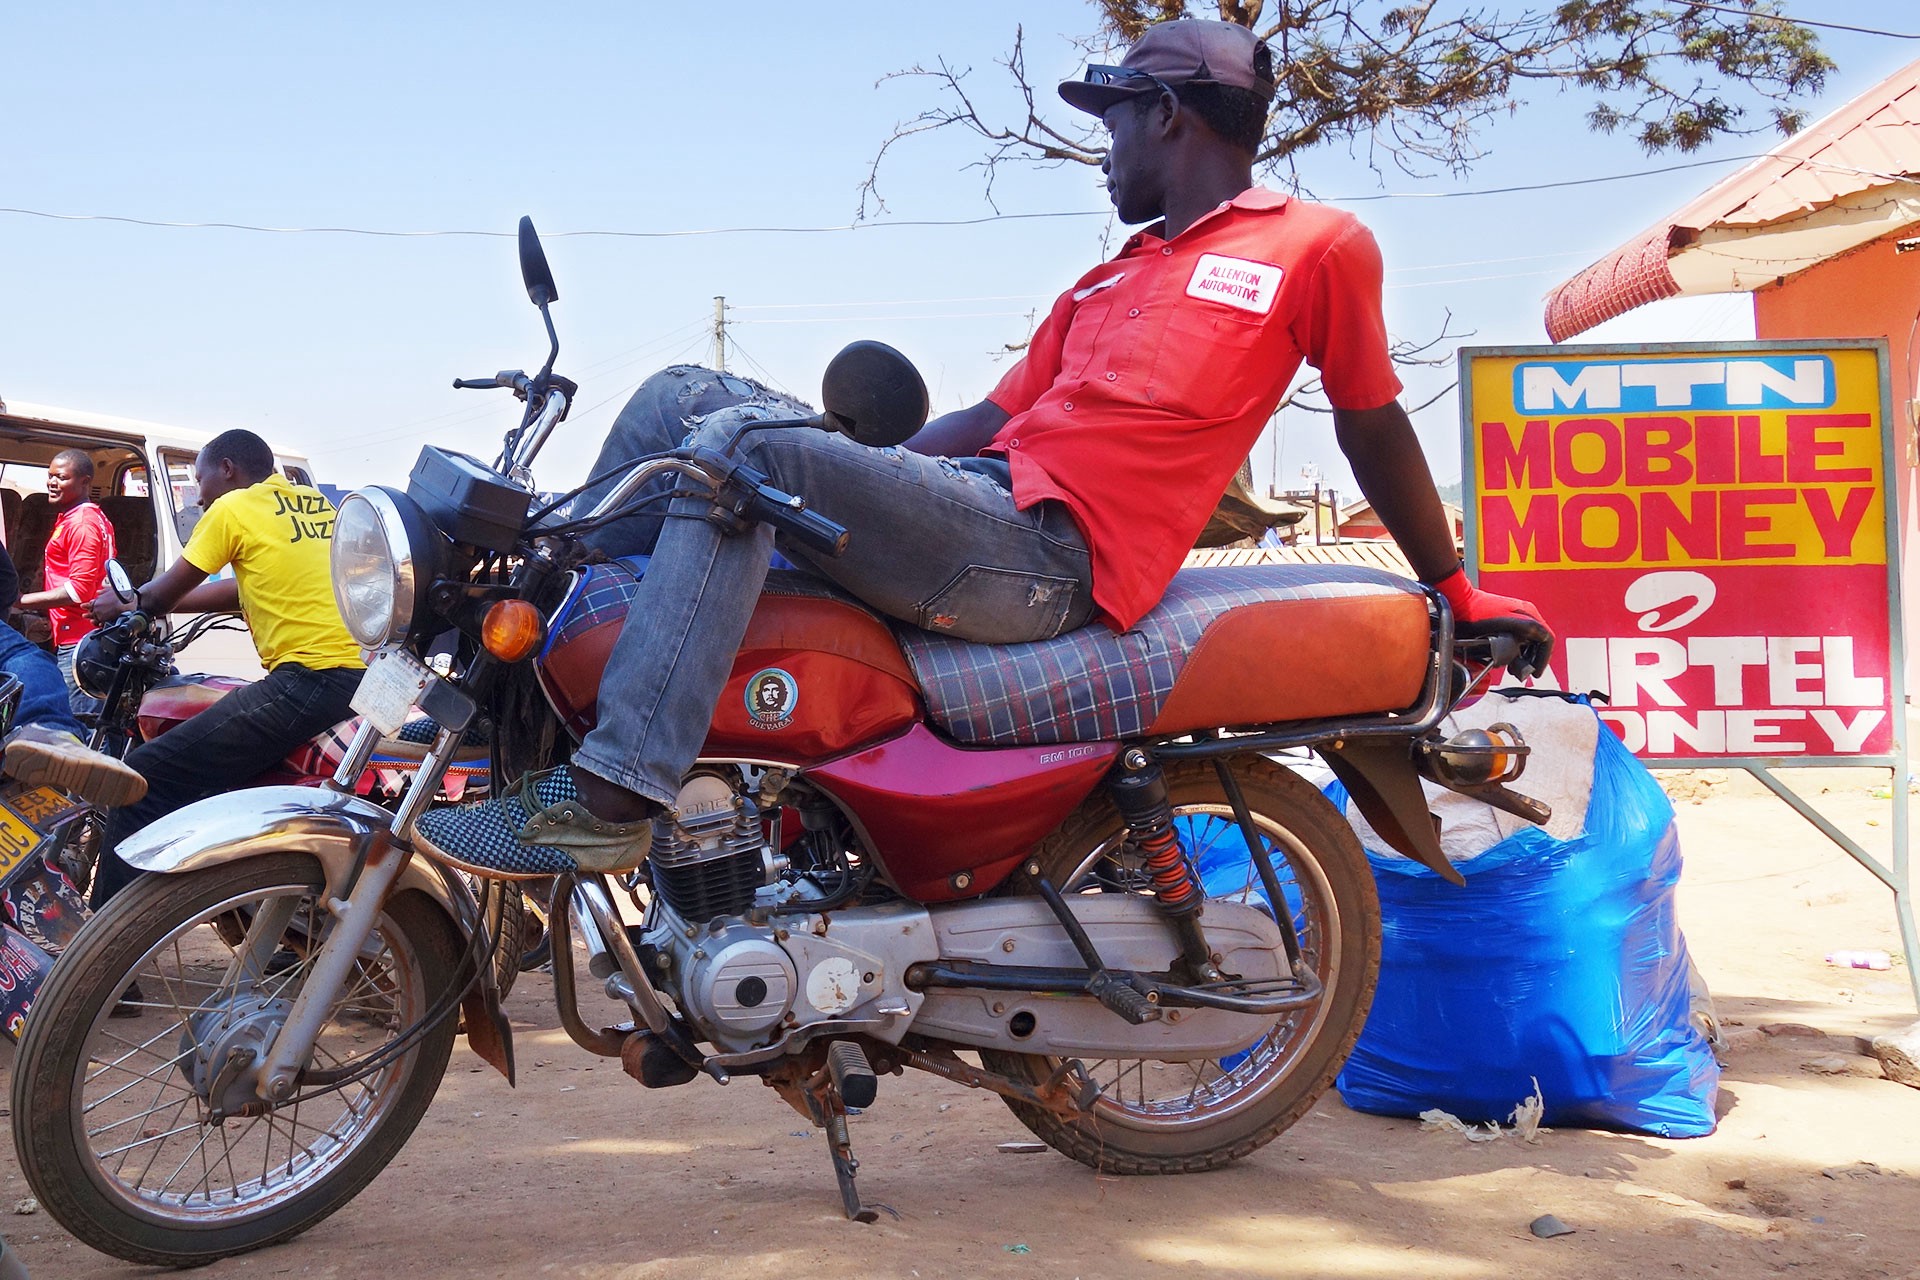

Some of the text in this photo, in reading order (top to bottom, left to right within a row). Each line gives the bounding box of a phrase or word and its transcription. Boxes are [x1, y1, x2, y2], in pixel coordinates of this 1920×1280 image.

[1209, 266, 1261, 286] ALLENTON
[1198, 279, 1260, 302] AUTOMOTIVE
[1523, 360, 1825, 410] MTN
[1481, 413, 1873, 490] MOBILE
[1481, 487, 1875, 564] MONEY
[749, 717, 791, 730] GUEVARA
[760, 713, 780, 722] CHE
